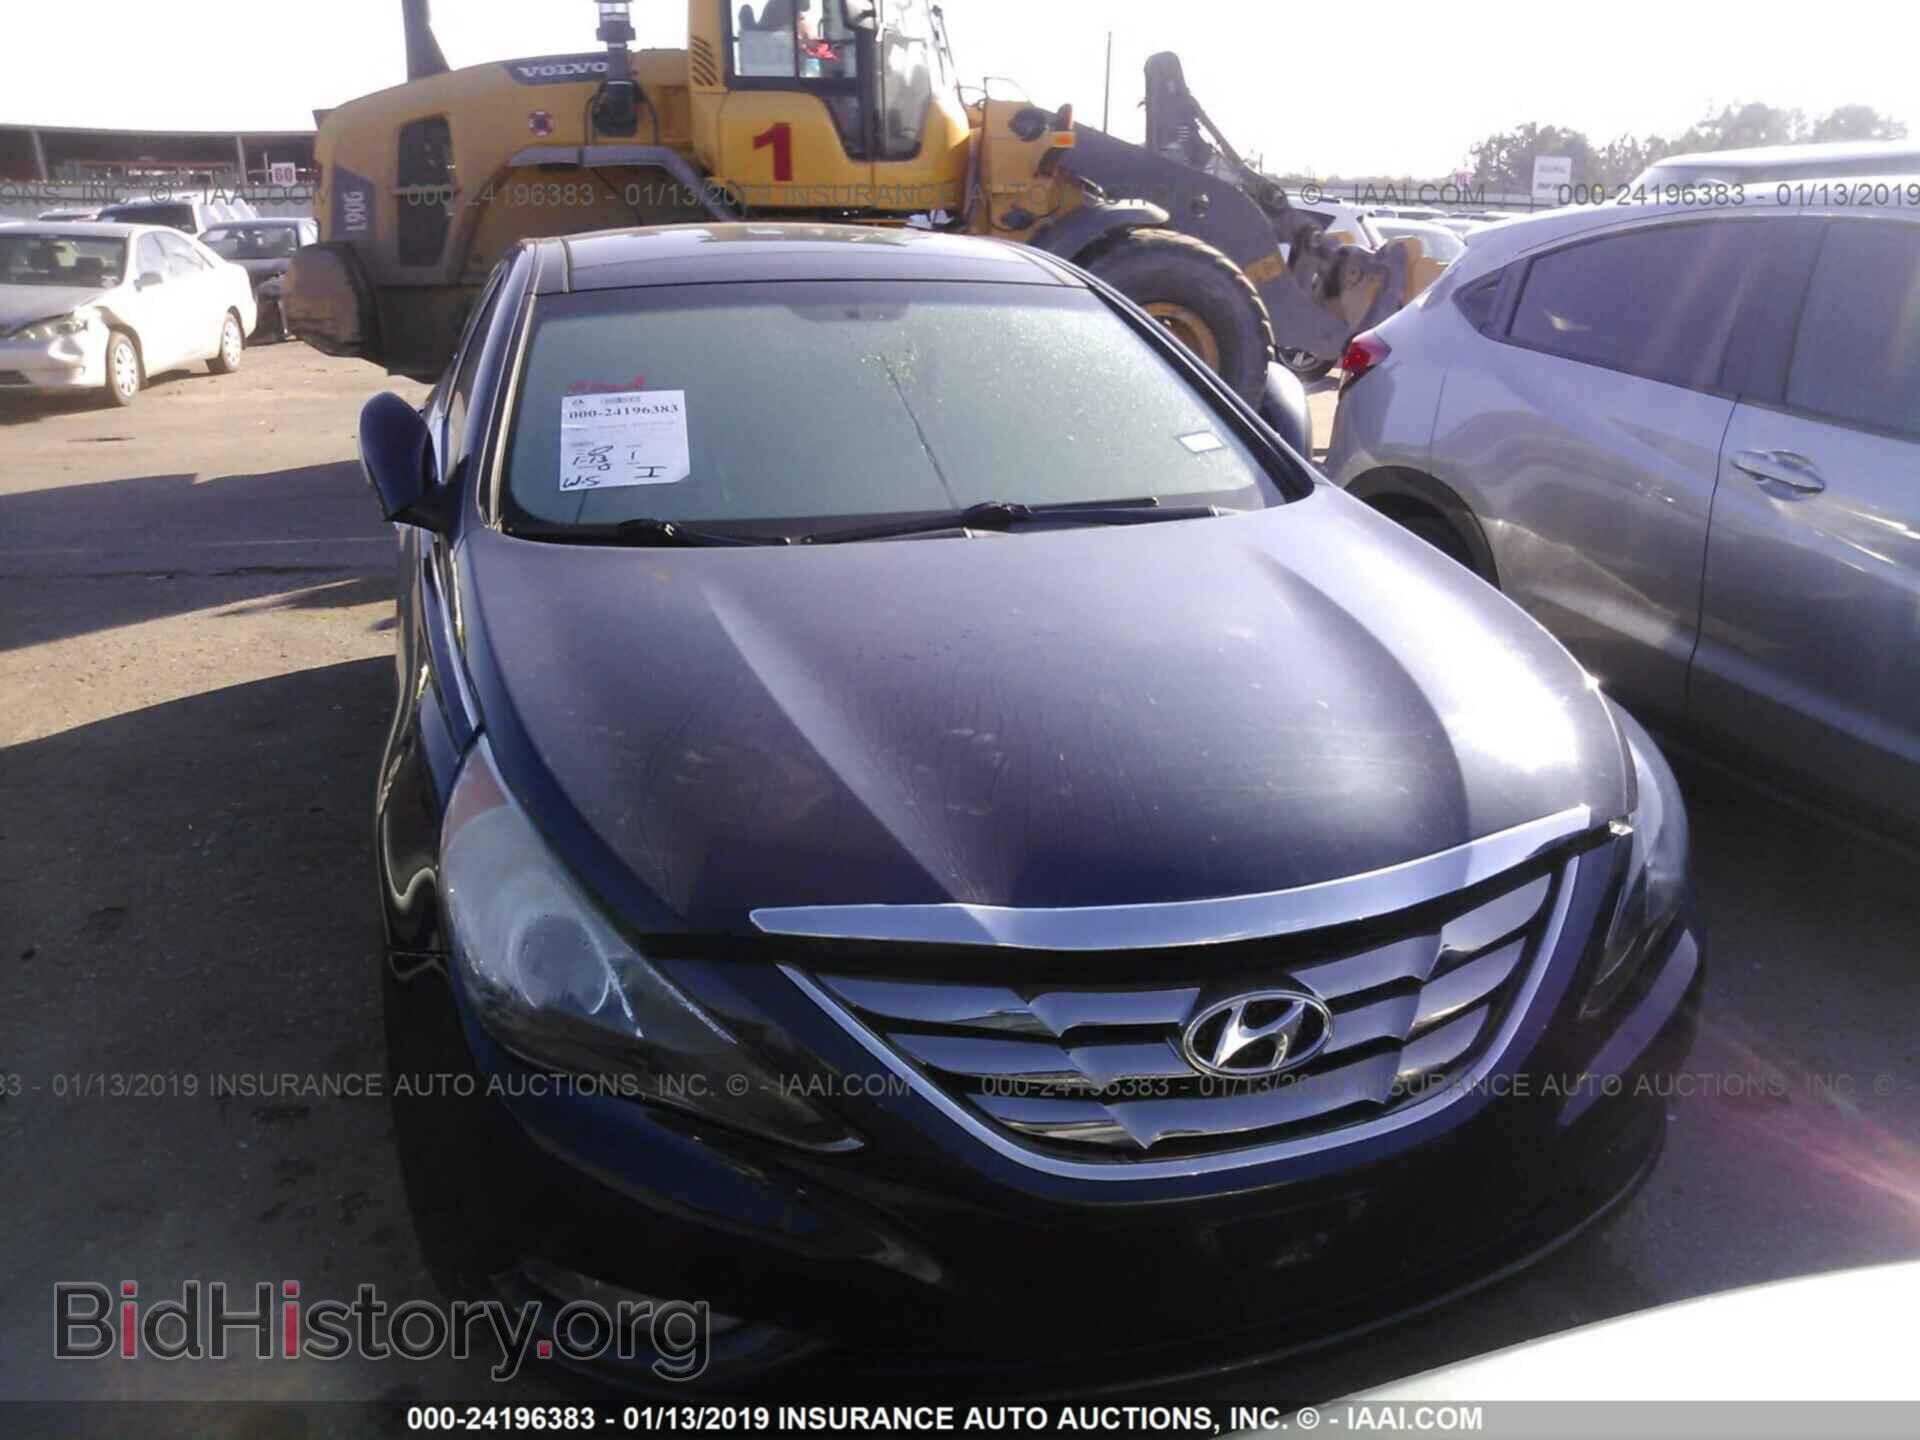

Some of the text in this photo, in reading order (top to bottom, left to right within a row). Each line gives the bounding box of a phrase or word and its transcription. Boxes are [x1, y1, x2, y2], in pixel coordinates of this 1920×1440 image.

[516, 62, 609, 77] VOLVO
[753, 122, 793, 182] 1
[568, 404, 680, 419] 000-24196383
